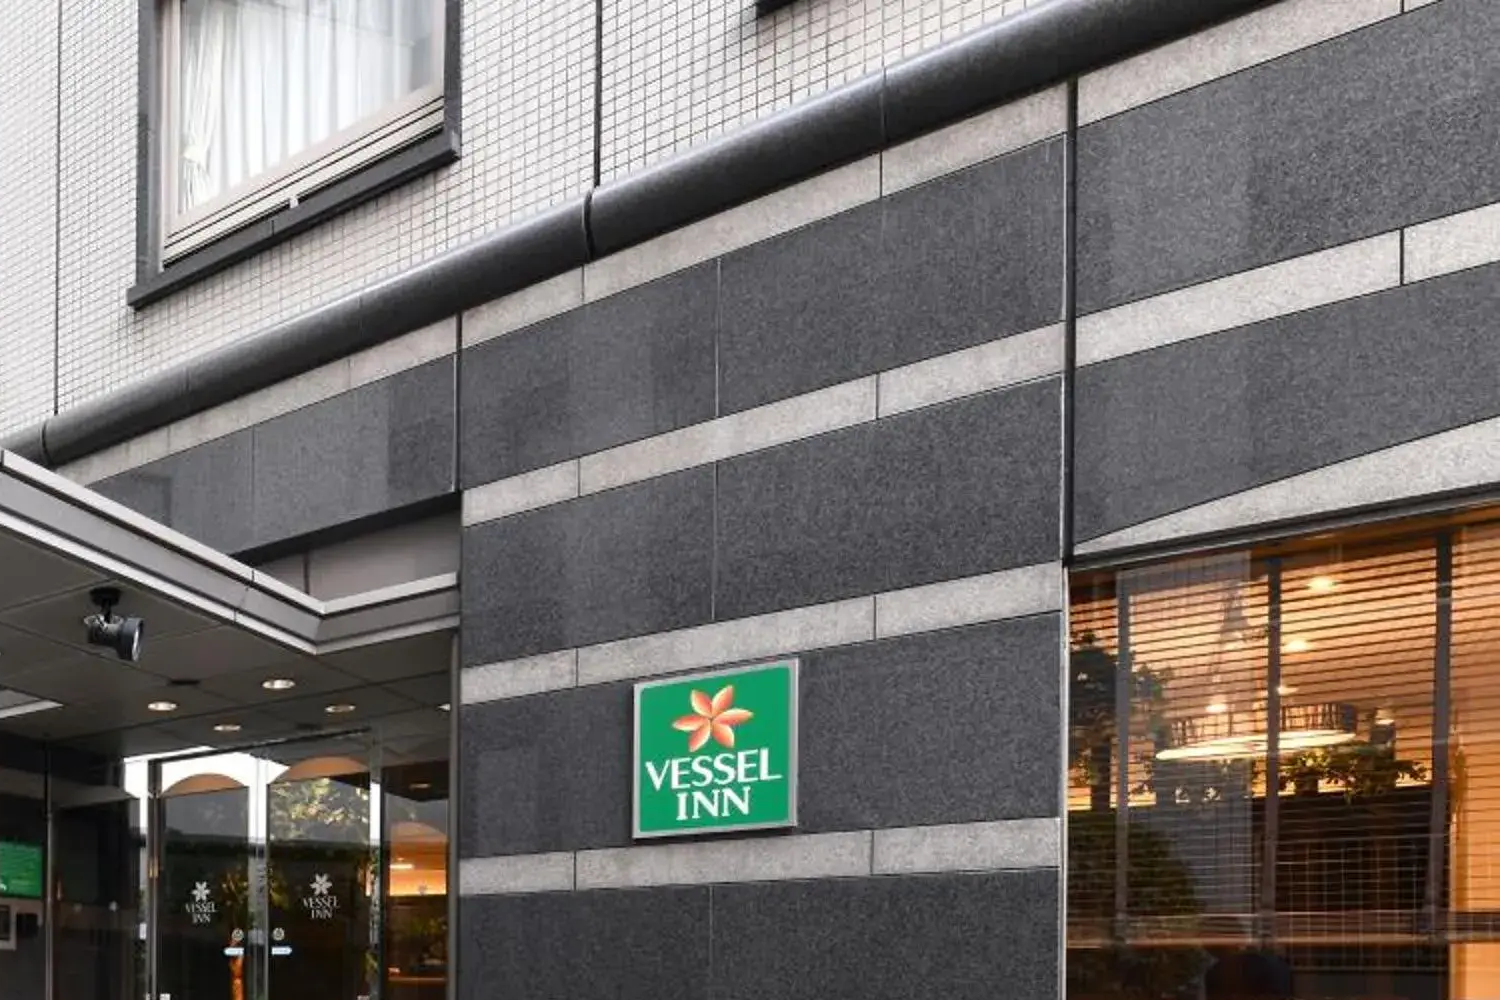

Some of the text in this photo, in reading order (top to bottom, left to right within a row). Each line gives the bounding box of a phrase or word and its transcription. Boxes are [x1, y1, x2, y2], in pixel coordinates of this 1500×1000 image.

[645, 747, 783, 792] VESSEL
[676, 786, 751, 821] INN
[185, 901, 217, 913] VESSEL
[303, 895, 340, 908] VESSEL
[311, 908, 333, 919] INN
